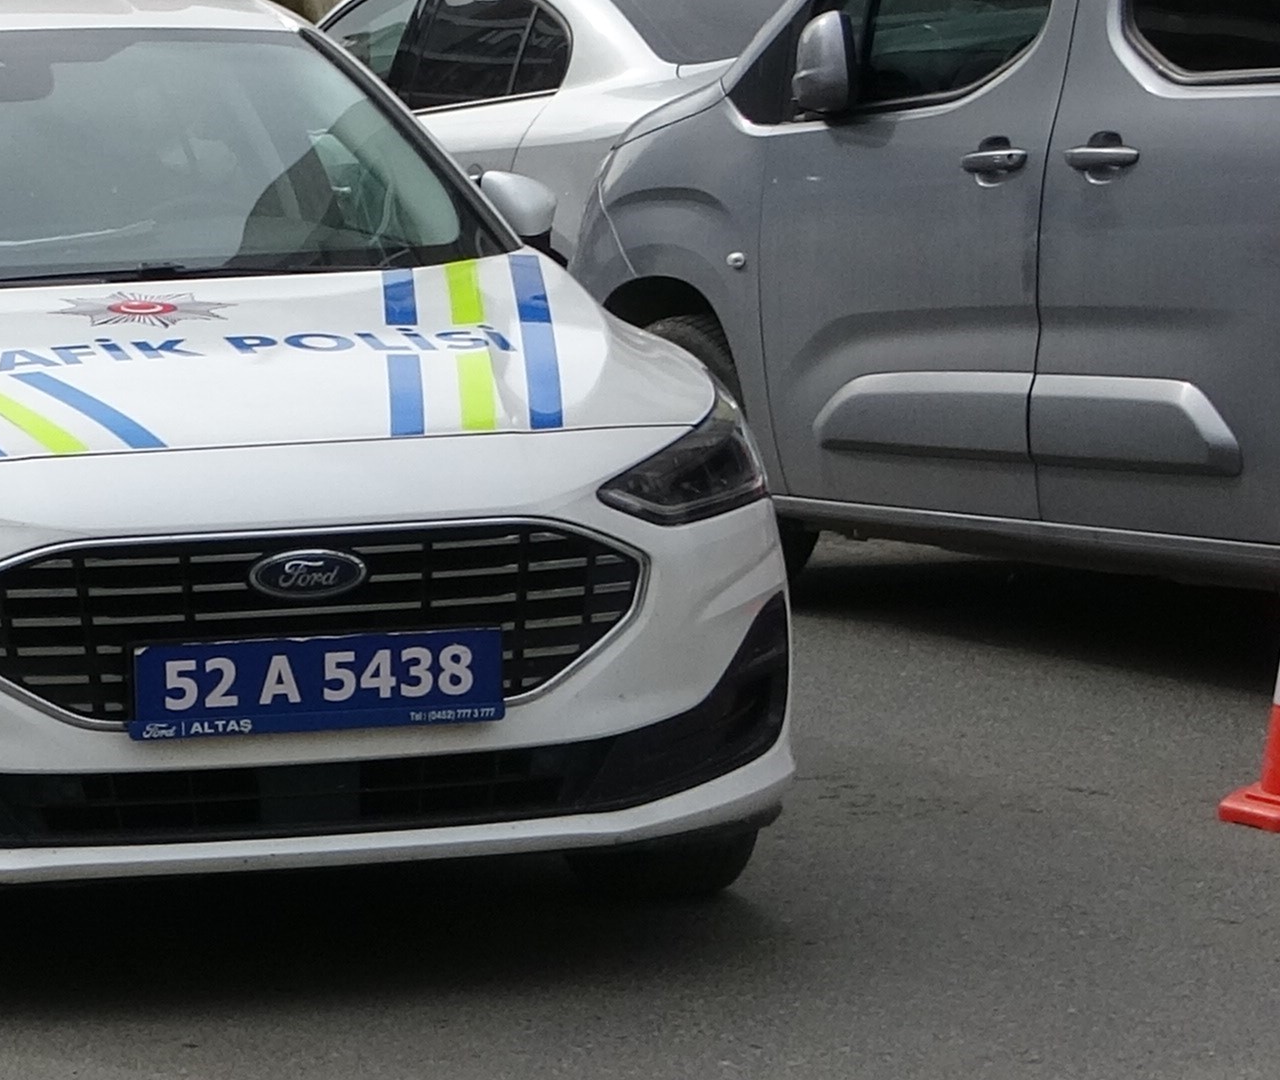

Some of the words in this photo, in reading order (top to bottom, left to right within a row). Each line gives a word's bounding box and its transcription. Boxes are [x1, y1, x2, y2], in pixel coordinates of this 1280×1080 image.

[223, 324, 517, 355] POLİSİ
[278, 560, 340, 588] Ford
[164, 657, 239, 712] 52
[258, 654, 302, 705] A
[322, 642, 474, 703] 5438
[142, 723, 177, 738] Ford
